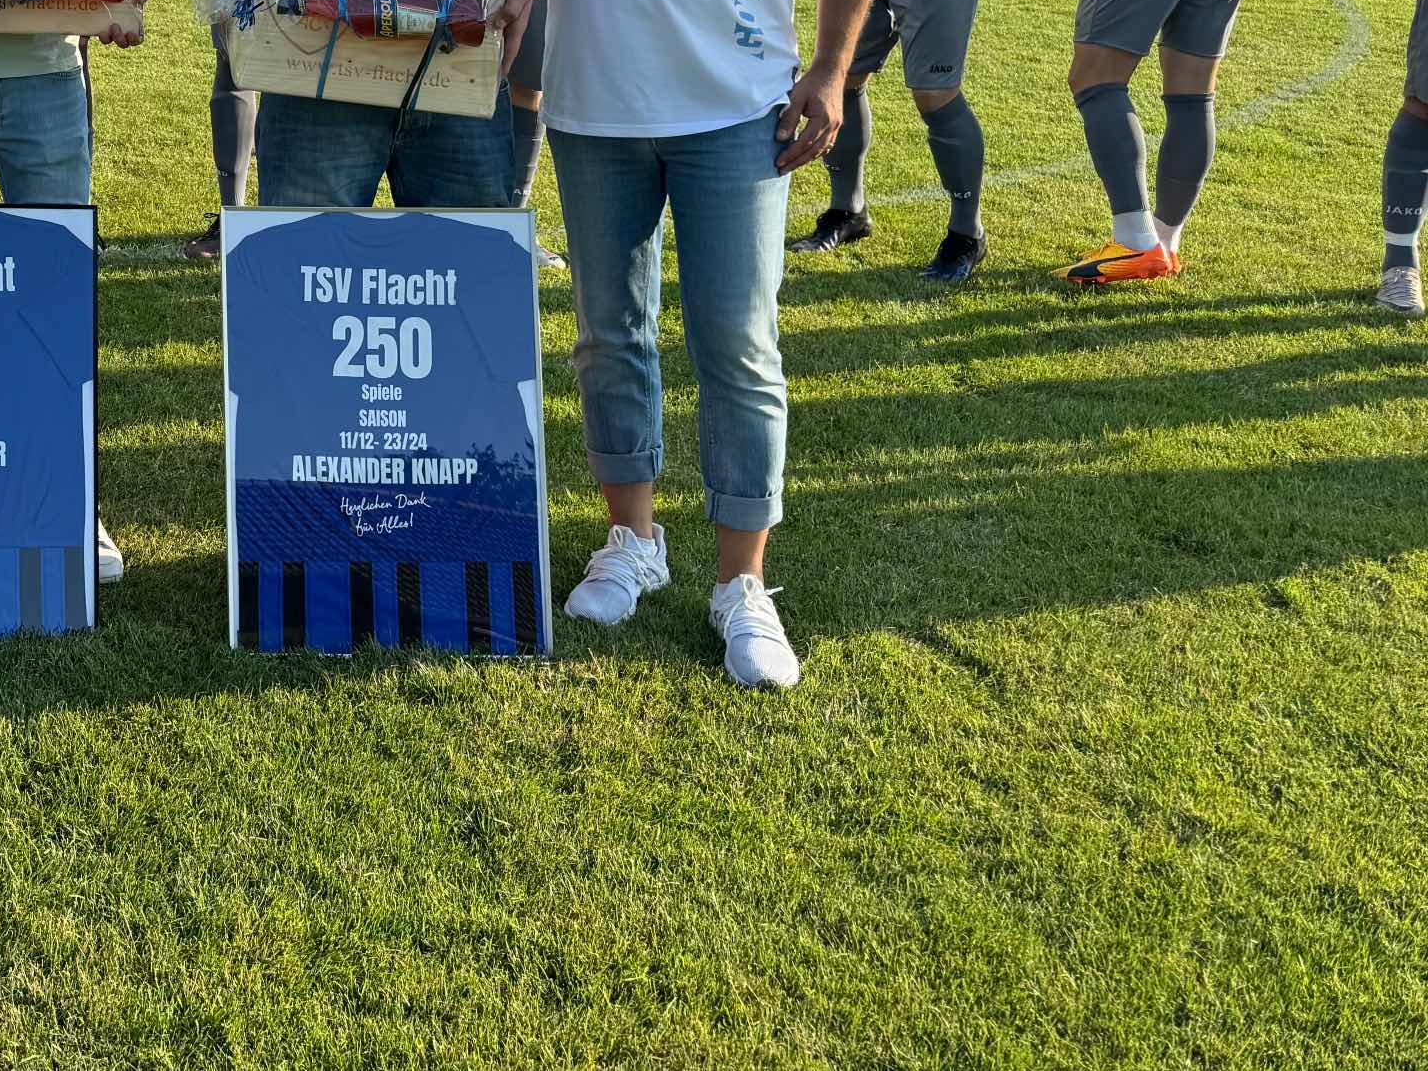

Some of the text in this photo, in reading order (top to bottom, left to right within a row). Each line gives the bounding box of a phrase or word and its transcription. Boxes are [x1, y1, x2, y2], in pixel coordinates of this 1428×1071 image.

[929, 65, 954, 74] JAKO
[1385, 204, 1423, 216] JAKO
[300, 265, 458, 306] TSV Flacht
[332, 315, 433, 379] 250
[361, 383, 403, 403] Spiele
[358, 409, 407, 428] SAISON
[339, 431, 428, 451] 11/12- 23/24
[292, 454, 478, 485] ALEXANDER KNAPP
[339, 490, 433, 517] Herzlichen Dank
[355, 512, 414, 537] für Alles!
